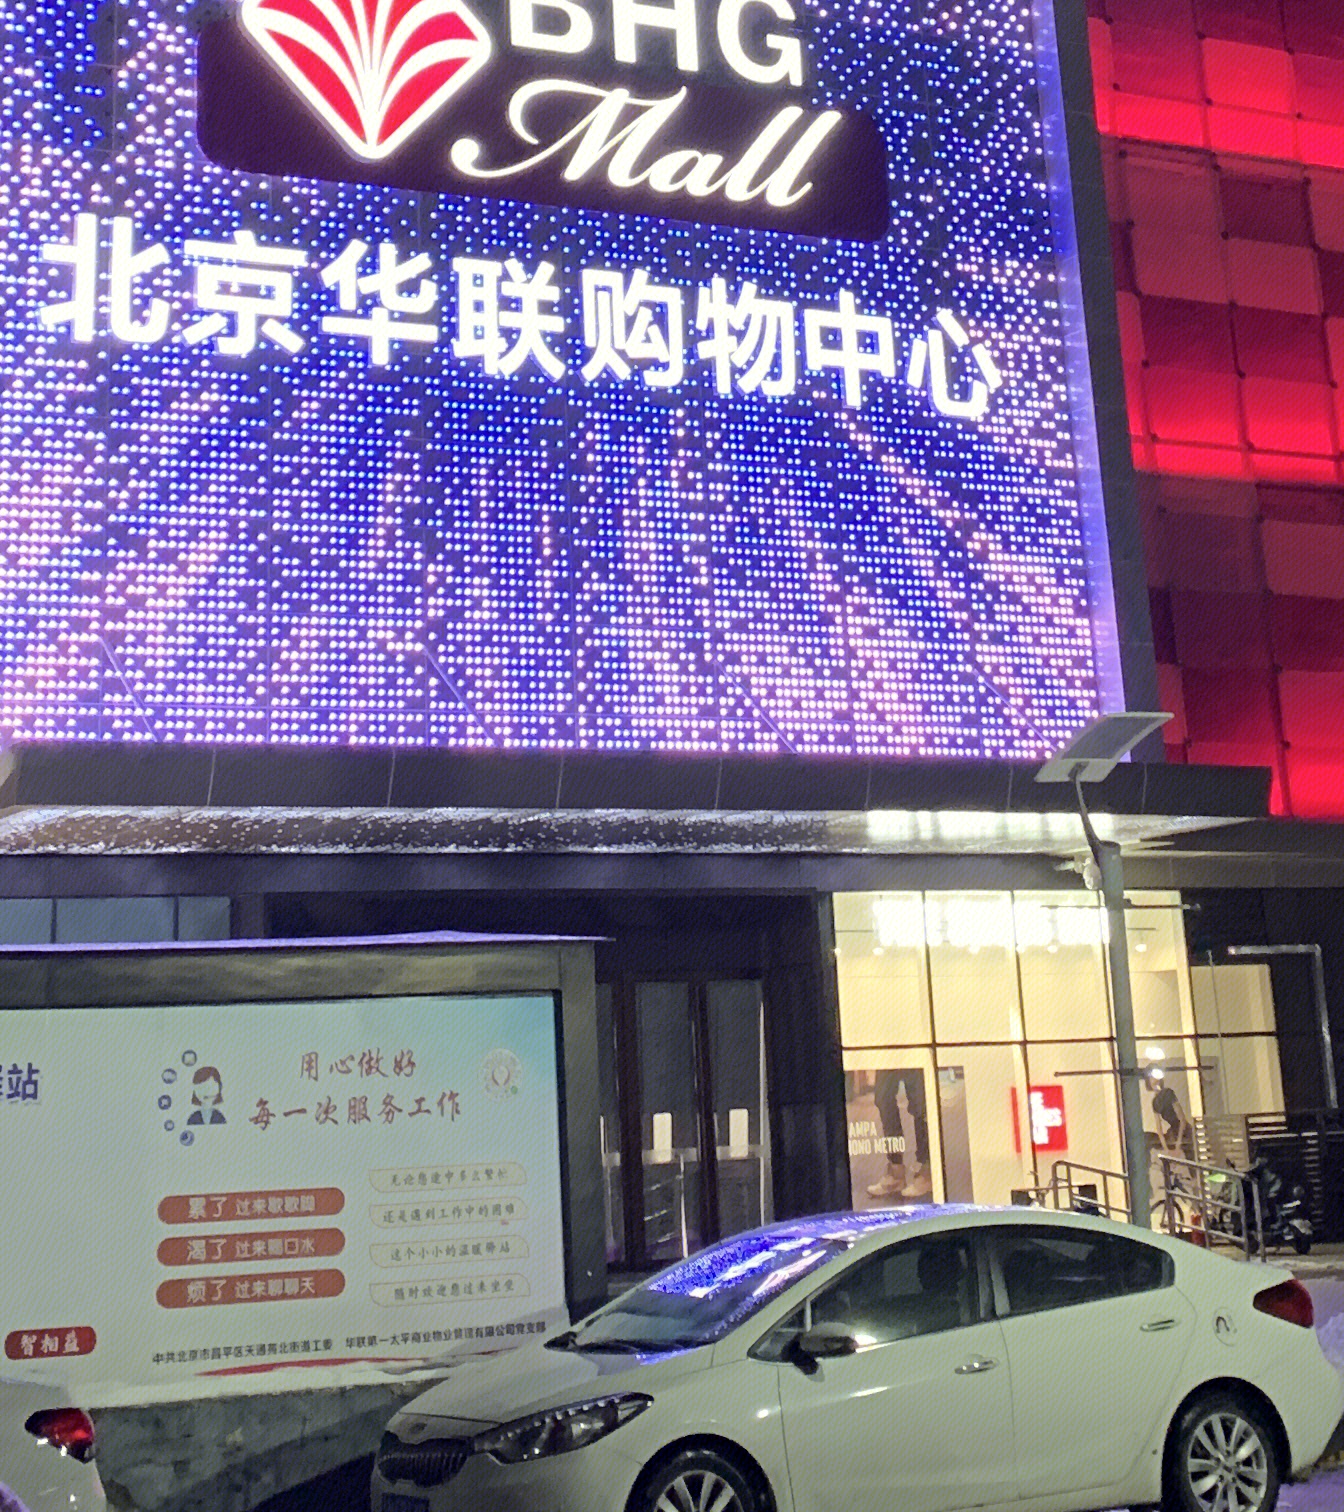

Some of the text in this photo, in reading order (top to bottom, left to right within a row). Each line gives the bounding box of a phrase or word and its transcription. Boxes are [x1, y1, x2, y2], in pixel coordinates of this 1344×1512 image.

[450, 79, 842, 207] Mall
[40, 213, 1003, 419] 北京华联购物中心
[299, 1048, 417, 1081] 用心做好
[248, 1090, 461, 1131] 每一次服务工作
[874, 1136, 905, 1154] METRO
[188, 1195, 316, 1220] 累了 过来歇歇脚
[187, 1238, 316, 1261] 渴了 过来喝口水
[187, 1277, 316, 1303] 烦了 过来聊聊天
